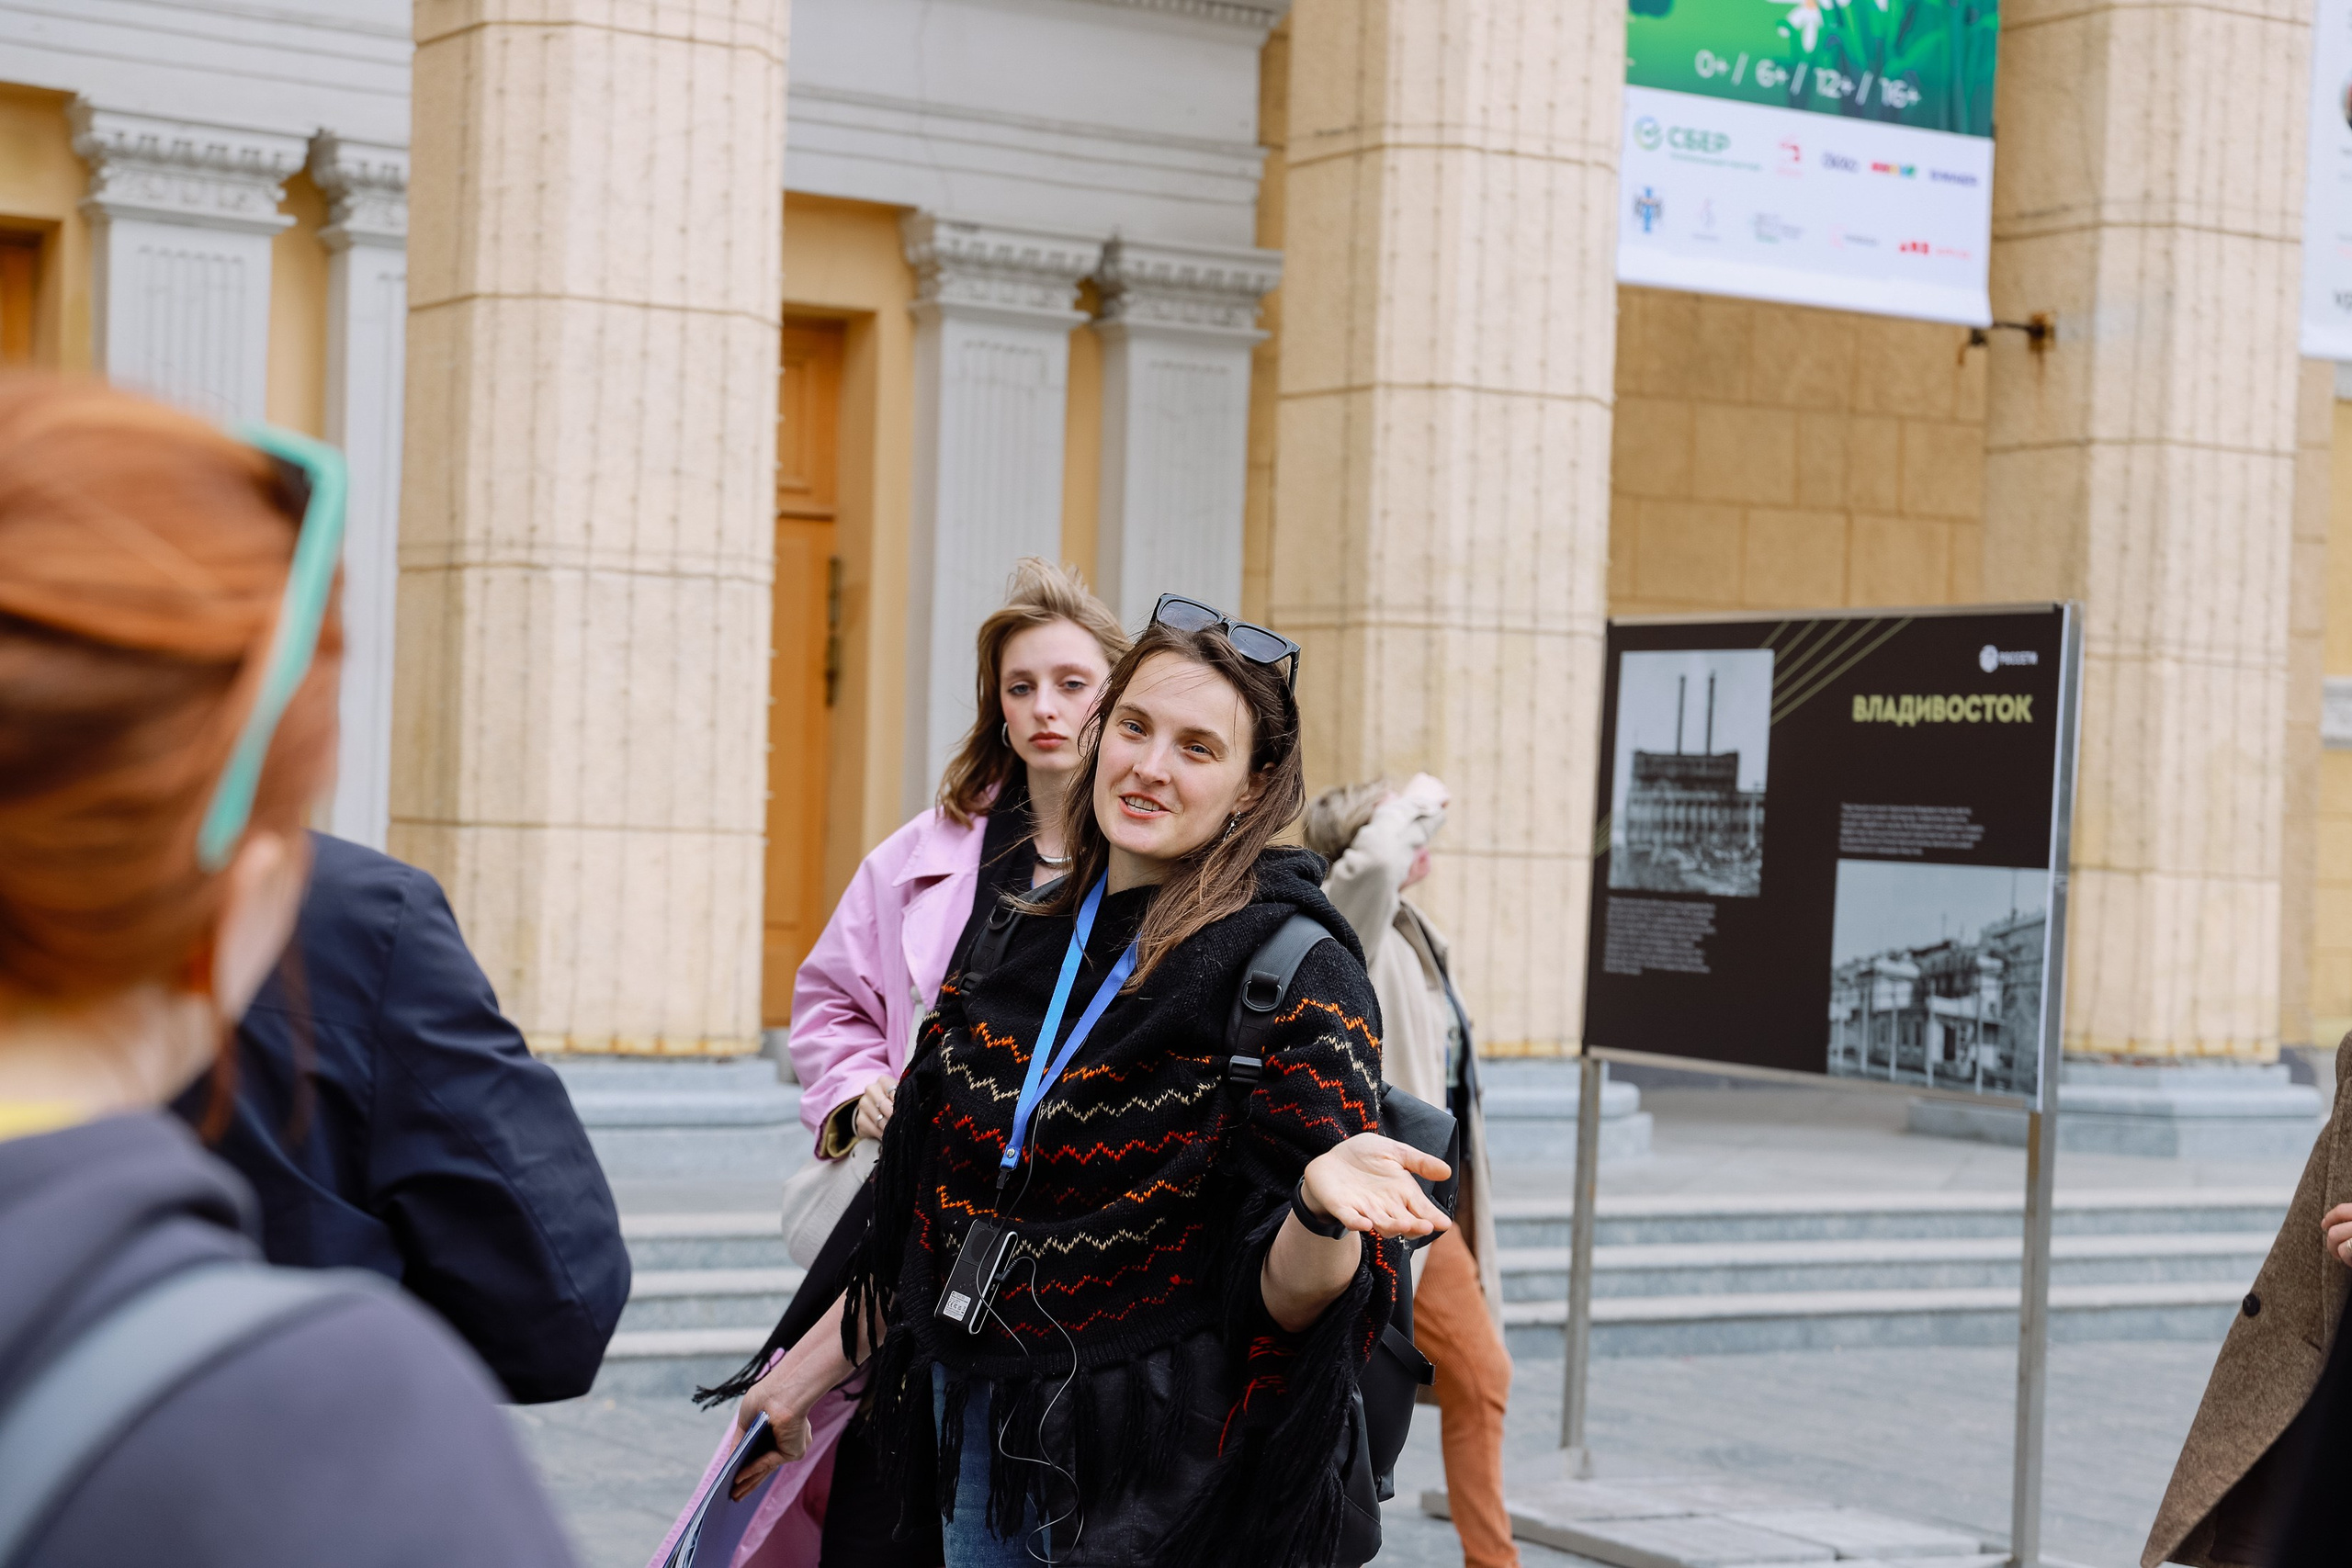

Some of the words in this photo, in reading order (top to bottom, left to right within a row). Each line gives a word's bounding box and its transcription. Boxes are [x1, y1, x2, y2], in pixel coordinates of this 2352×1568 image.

[1695, 49, 1729, 79] 0+
[1756, 59, 1789, 88] 6+
[1814, 68, 1855, 99] 12+
[1880, 78, 1921, 108] 16+
[1668, 124, 1731, 154] СБЕР
[1852, 695, 2032, 726] ВЛАДИВОСТОК
